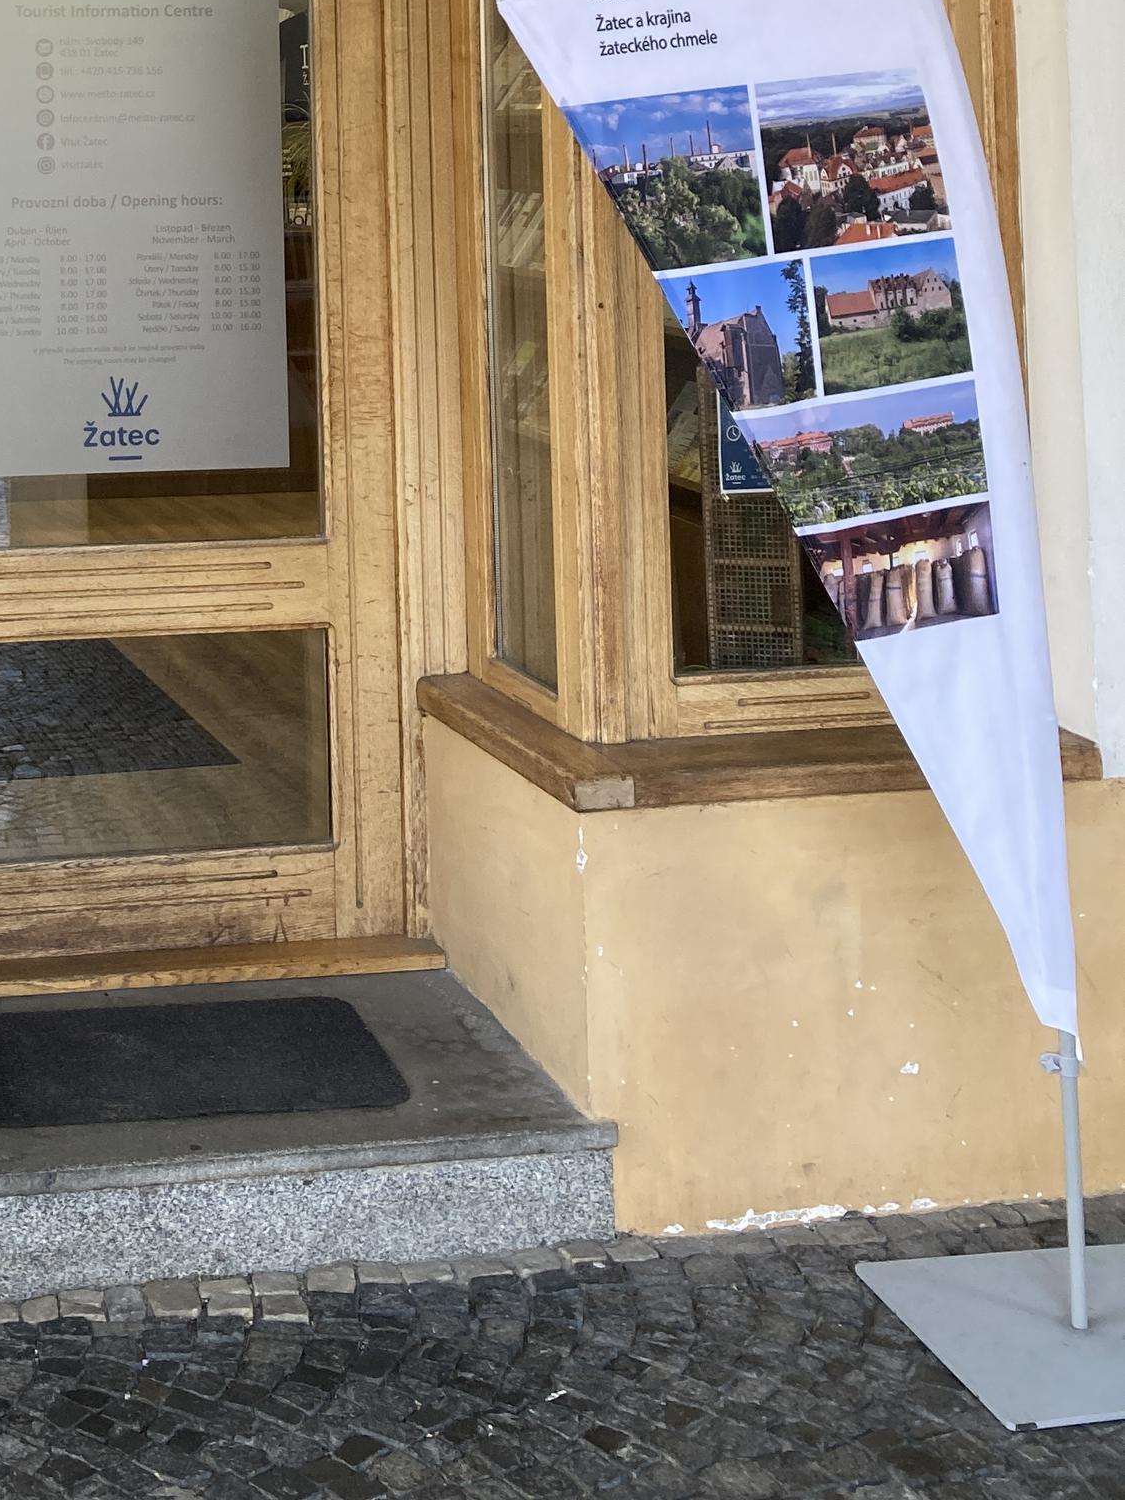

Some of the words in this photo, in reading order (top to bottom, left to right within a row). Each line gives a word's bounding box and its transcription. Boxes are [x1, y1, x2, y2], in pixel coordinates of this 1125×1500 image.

[14, 4, 66, 18] Tourist
[71, 4, 159, 18] Information
[164, 4, 213, 17] Centre
[596, 13, 634, 32] Žatec
[636, 17, 644, 27] a
[646, 9, 691, 29] krajina
[600, 38, 668, 57] žateckého
[670, 31, 718, 49] chmele
[12, 196, 68, 209] Provozní
[73, 195, 107, 208] doba
[121, 195, 177, 210] Opening
[181, 194, 223, 206] hours:
[155, 223, 193, 234] Listopad
[34, 238, 72, 247] October
[151, 235, 198, 245] November
[206, 234, 236, 244] March
[83, 420, 161, 448] Žatec
